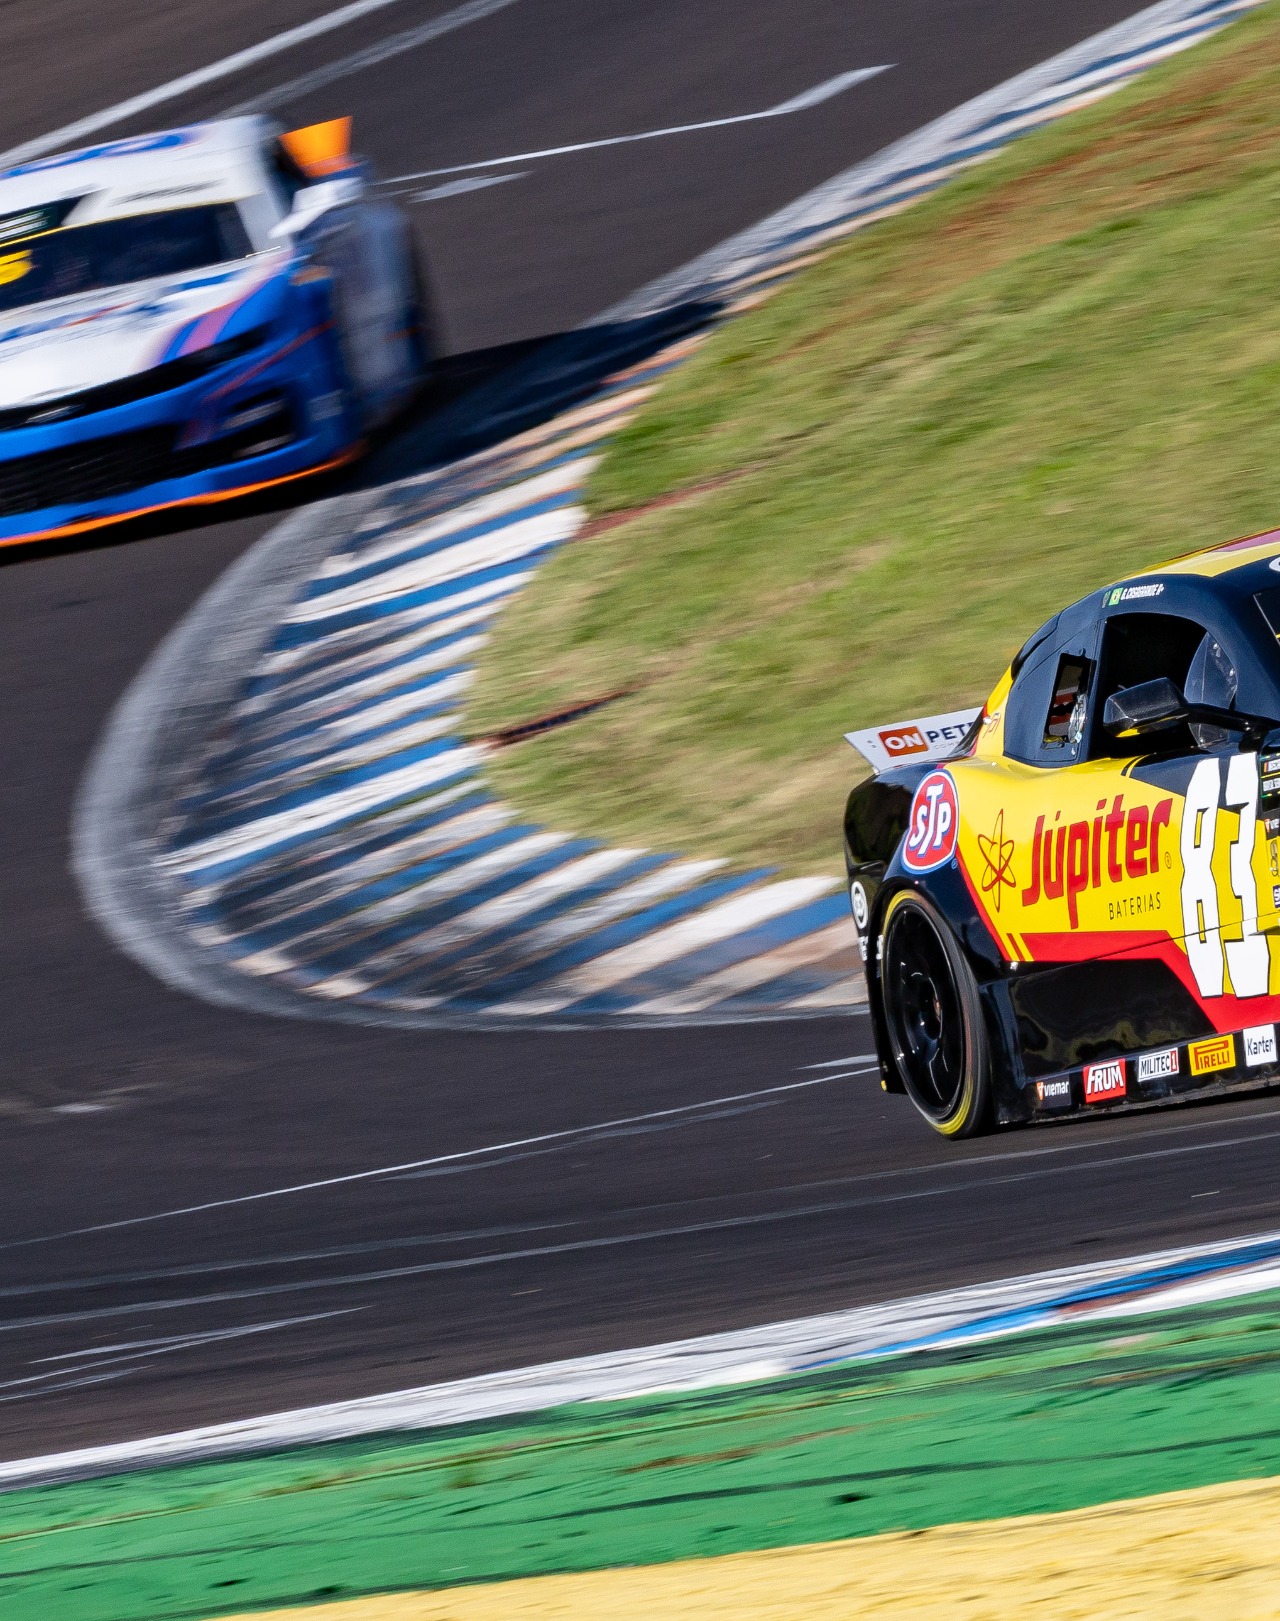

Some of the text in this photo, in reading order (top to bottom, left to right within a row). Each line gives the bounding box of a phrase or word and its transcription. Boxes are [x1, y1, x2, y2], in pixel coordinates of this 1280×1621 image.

[884, 732, 924, 750] ON
[925, 721, 975, 744] PET
[908, 783, 952, 858] STP
[1021, 793, 1173, 930] Júpiter
[1180, 751, 1270, 999] 83
[1108, 891, 1162, 920] BATERIAS
[1193, 1040, 1230, 1071] PIRELLI
[1247, 1036, 1274, 1056] Karter
[1086, 1061, 1124, 1095] FRUM
